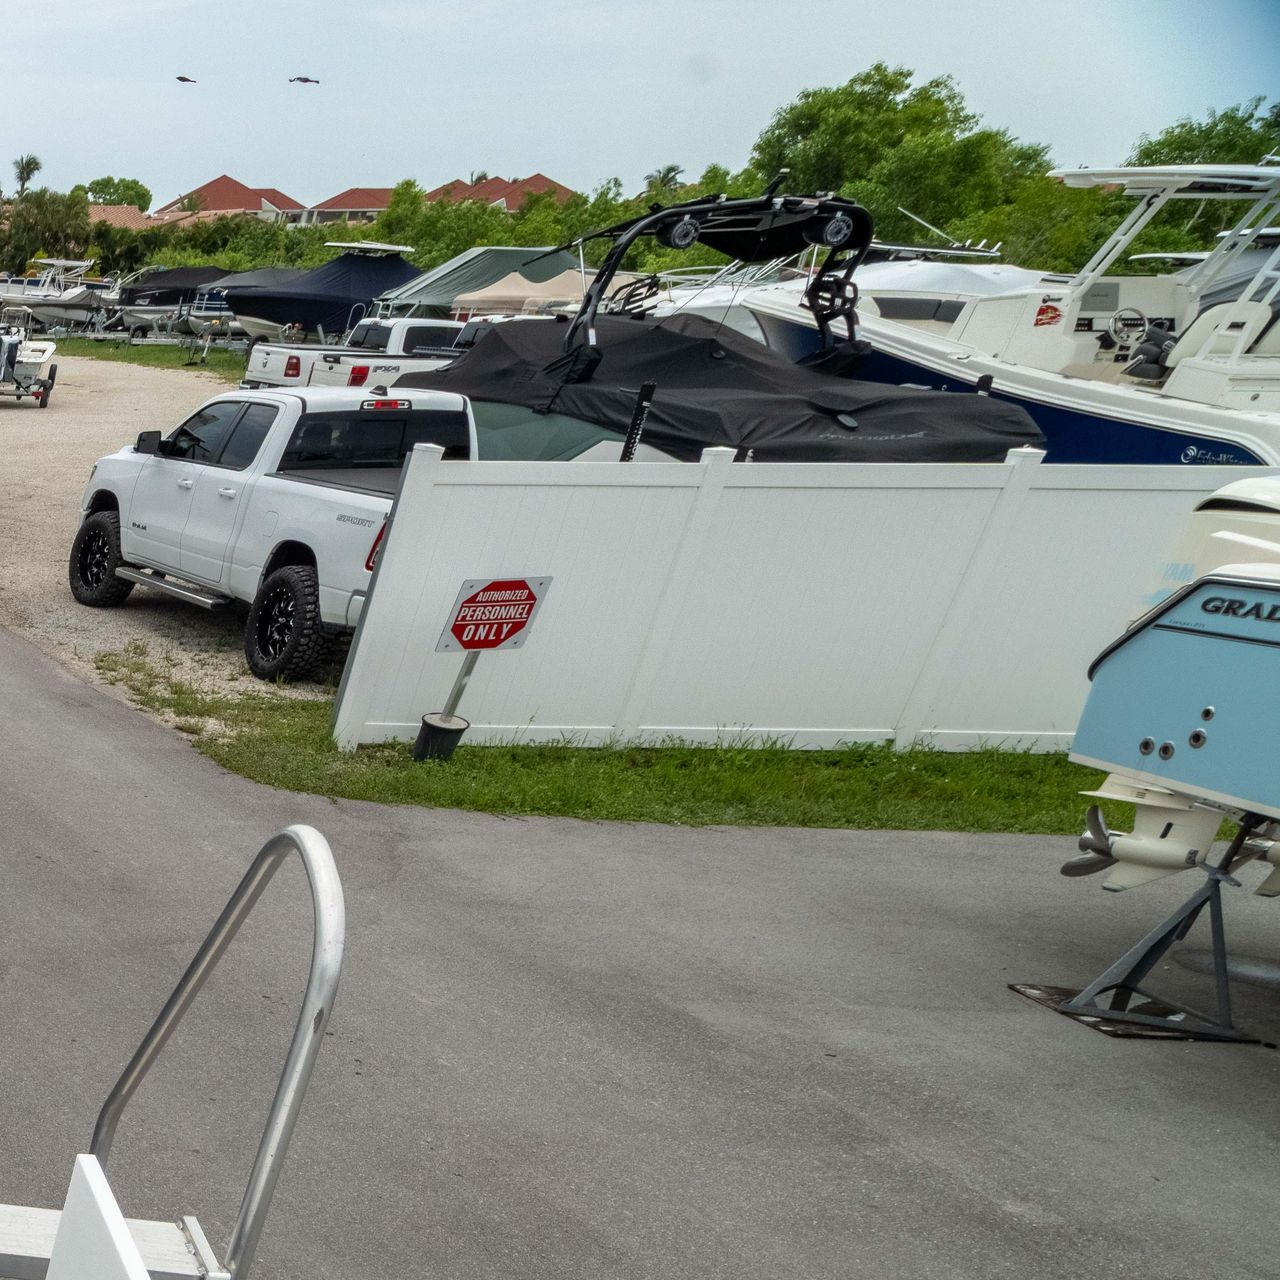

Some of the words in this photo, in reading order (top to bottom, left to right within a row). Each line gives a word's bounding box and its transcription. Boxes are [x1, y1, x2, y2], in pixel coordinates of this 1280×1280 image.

[336, 514, 375, 528] SPORT
[476, 589, 529, 602] AUTHORIZED
[457, 604, 530, 621] PERSONNEL
[462, 623, 513, 641] ONLY
